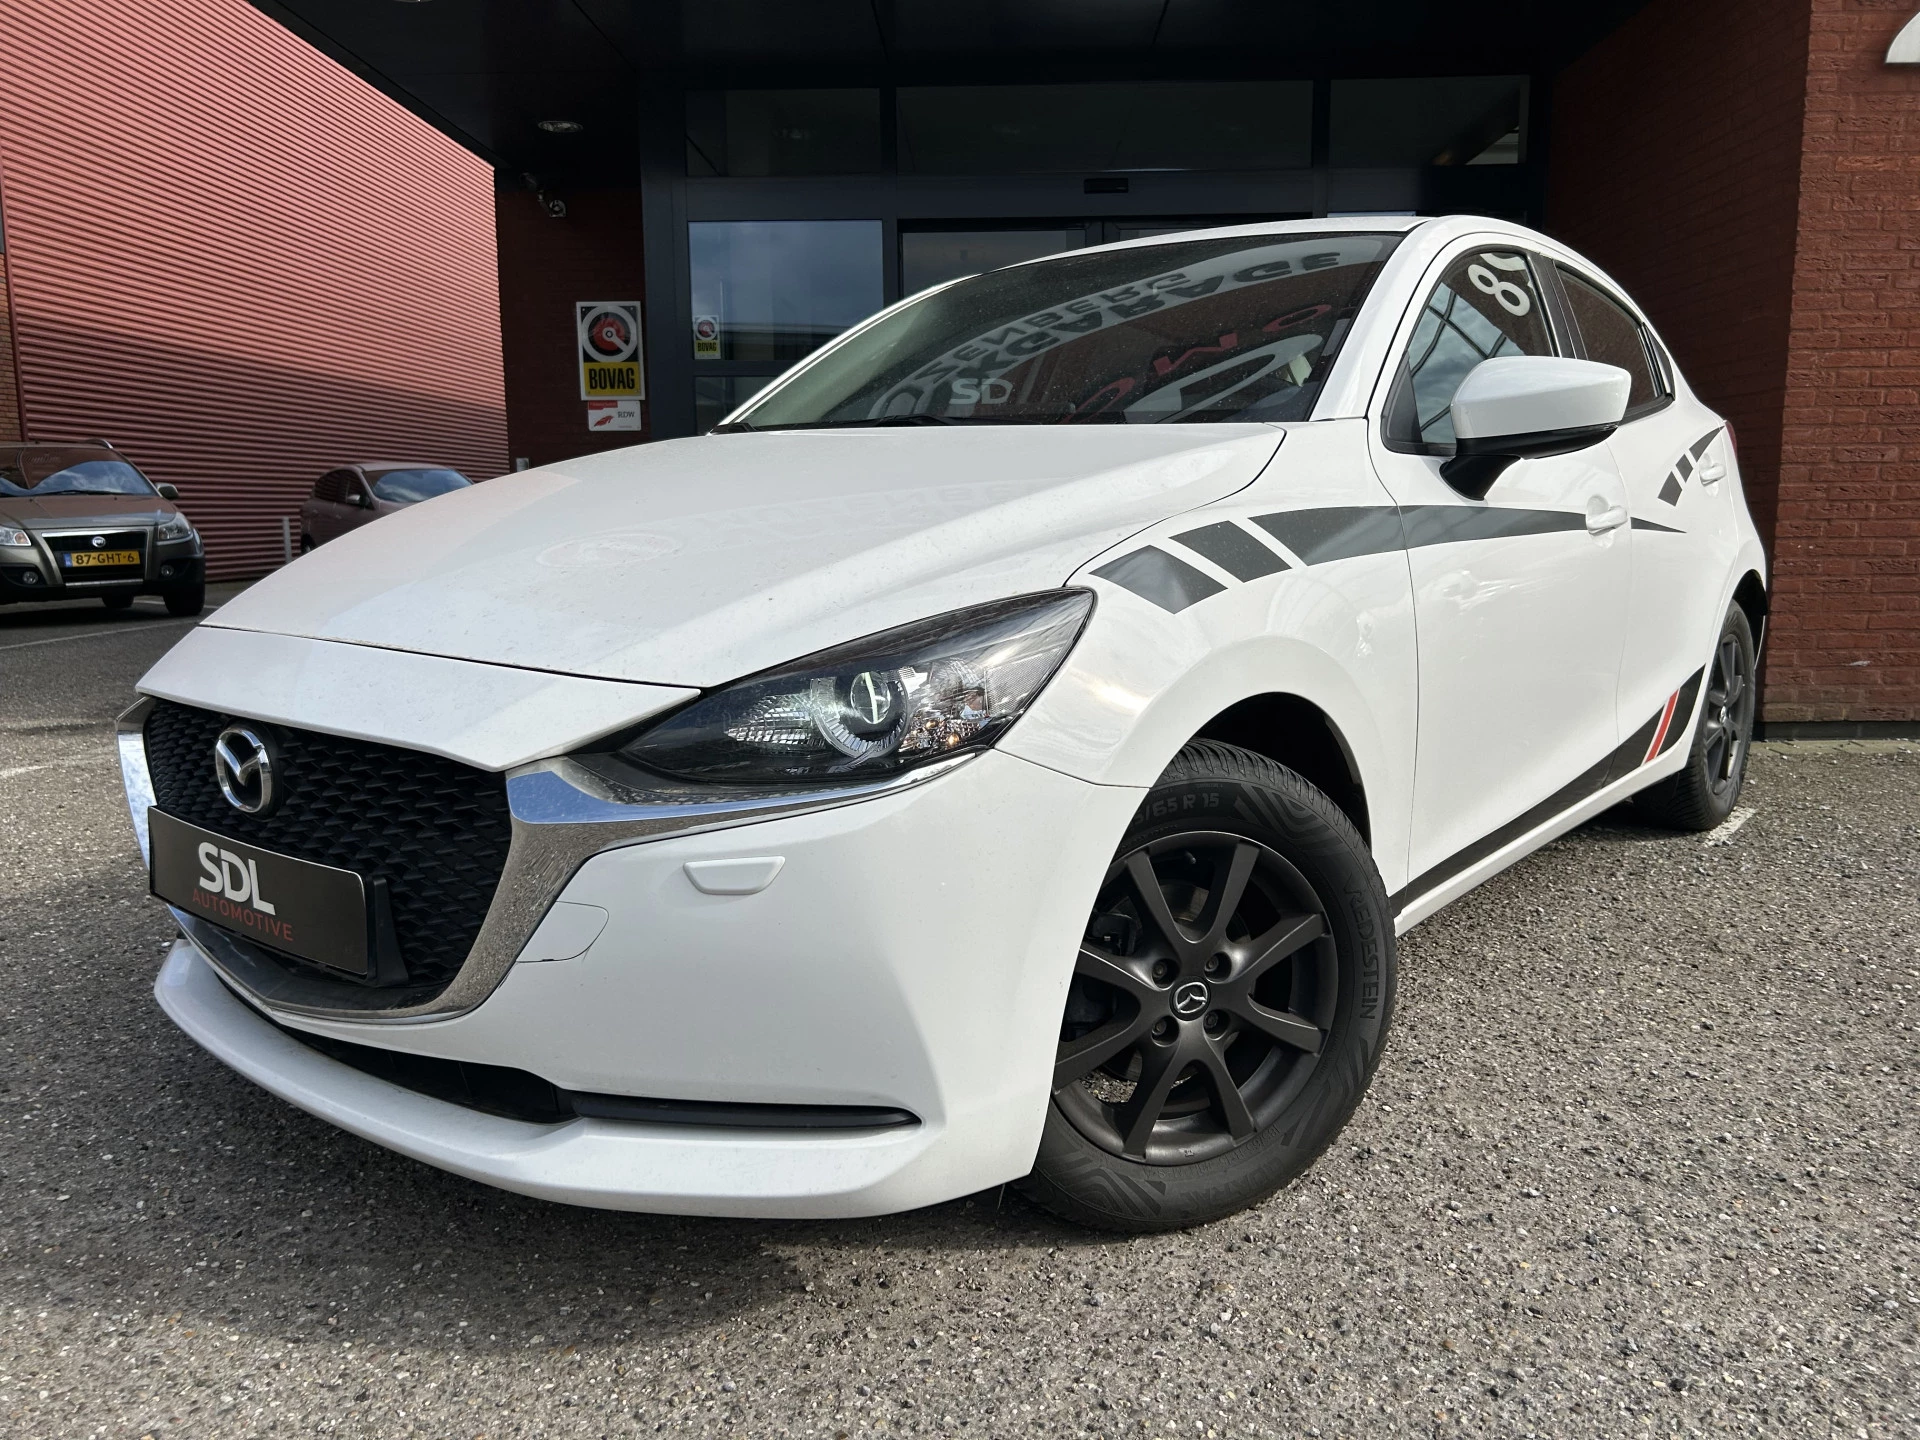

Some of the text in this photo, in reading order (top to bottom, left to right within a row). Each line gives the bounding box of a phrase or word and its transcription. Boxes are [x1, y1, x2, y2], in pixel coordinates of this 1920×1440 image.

[697, 342, 717, 351] BOVAG
[588, 367, 635, 389] BOVAG
[75, 553, 135, 565] 87-GHT-6
[198, 841, 276, 916] SDL
[192, 888, 294, 942] AUTOMOTIVE
